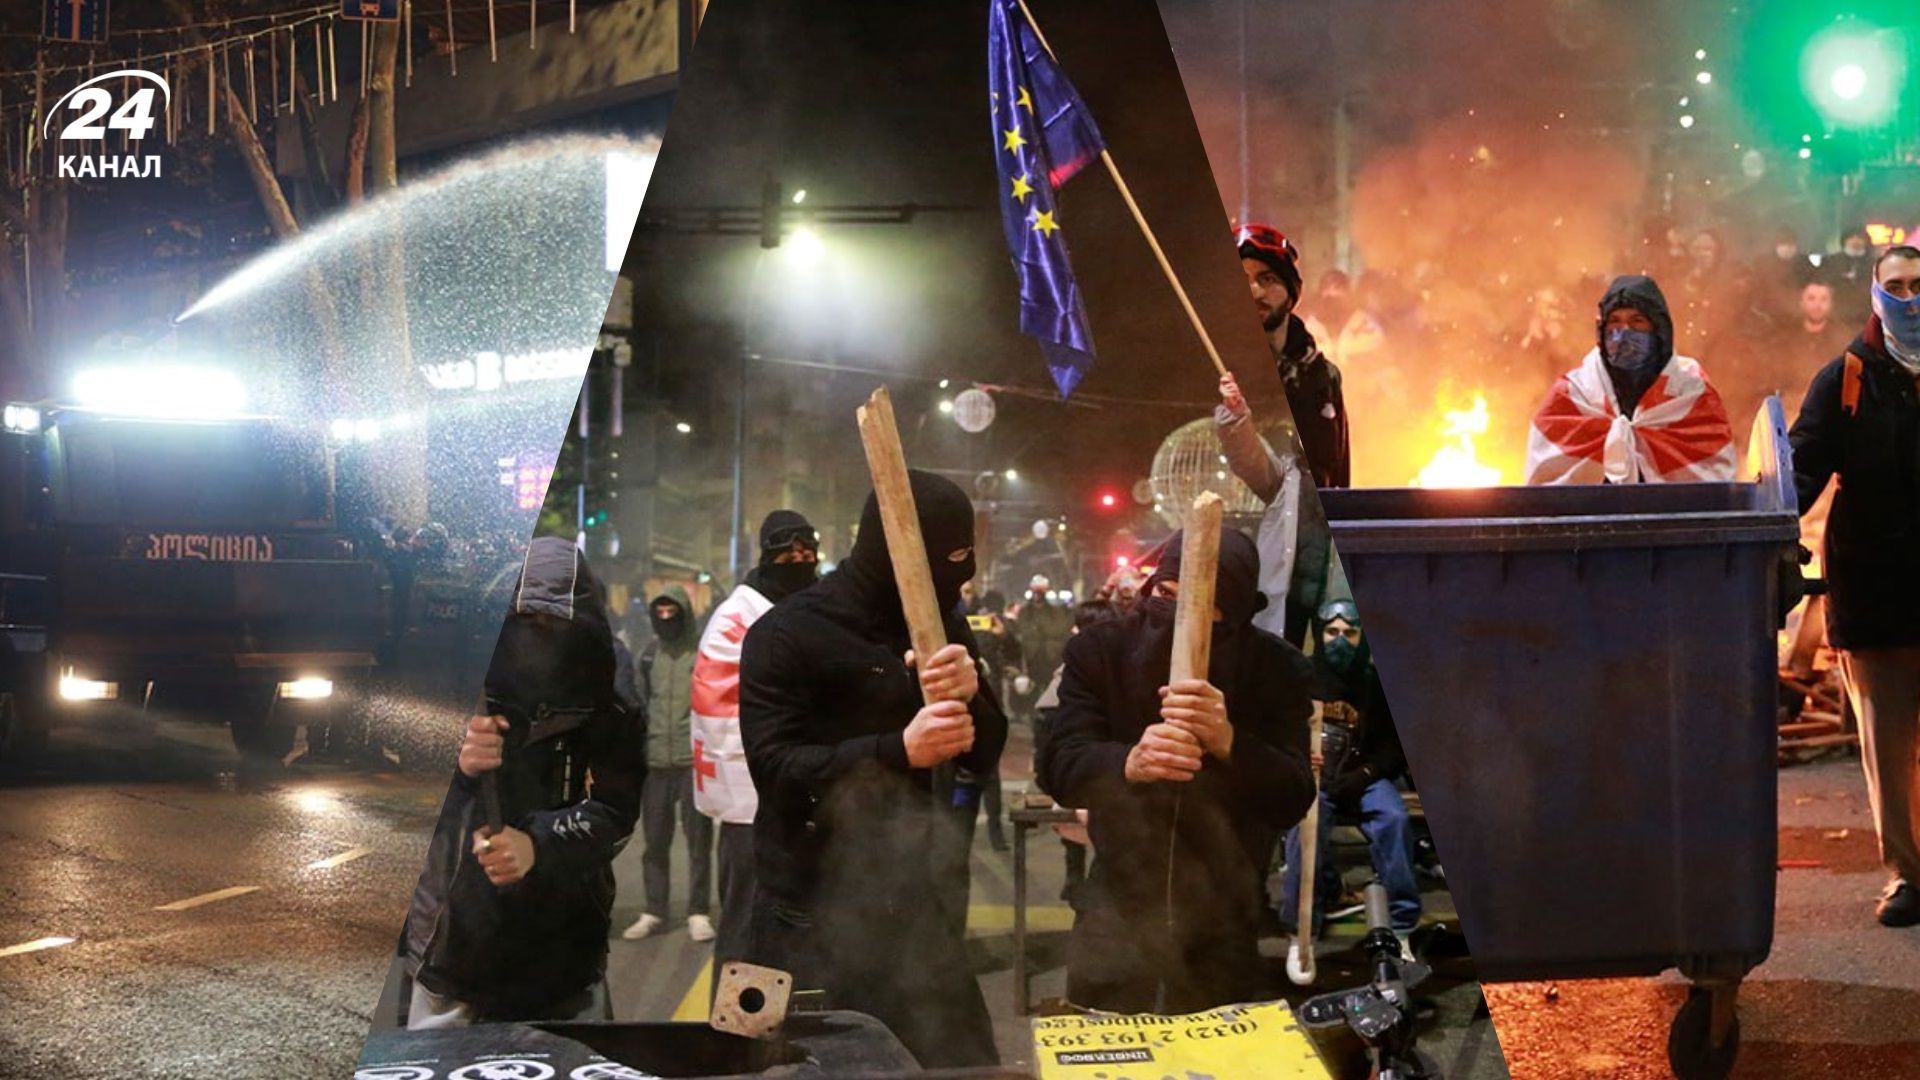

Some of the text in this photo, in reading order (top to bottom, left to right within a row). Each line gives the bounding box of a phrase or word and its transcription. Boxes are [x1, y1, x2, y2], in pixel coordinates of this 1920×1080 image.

[146, 533, 273, 562] პოლიცია
[1041, 1019, 1258, 1047] (032) 2 193 393
